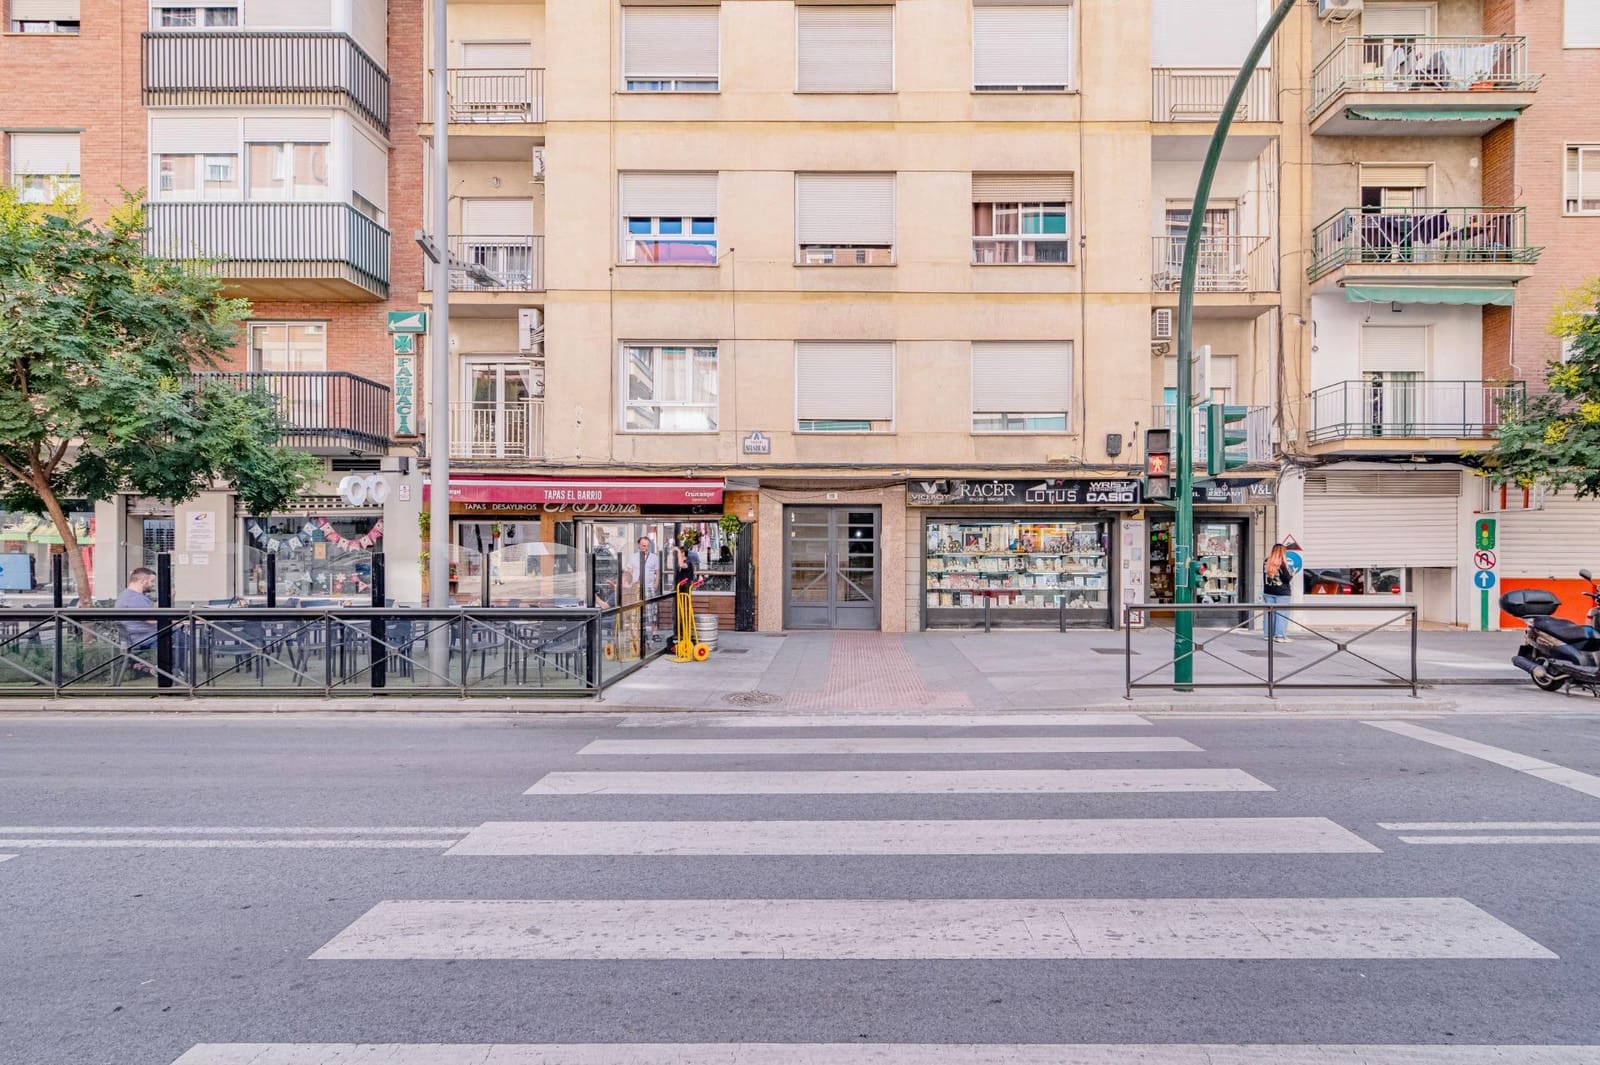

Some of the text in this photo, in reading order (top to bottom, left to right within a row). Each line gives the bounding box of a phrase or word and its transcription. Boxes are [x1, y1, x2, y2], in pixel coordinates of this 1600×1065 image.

[396, 357, 413, 434] FARMACIA
[544, 490, 603, 500] TAPAS EL BARRIO
[960, 483, 1016, 497] RACER
[1250, 484, 1272, 495] V&L
[1025, 489, 1077, 502] LOTUS
[1086, 492, 1134, 502] CASIO
[492, 503, 537, 511] DESAYUNOS
